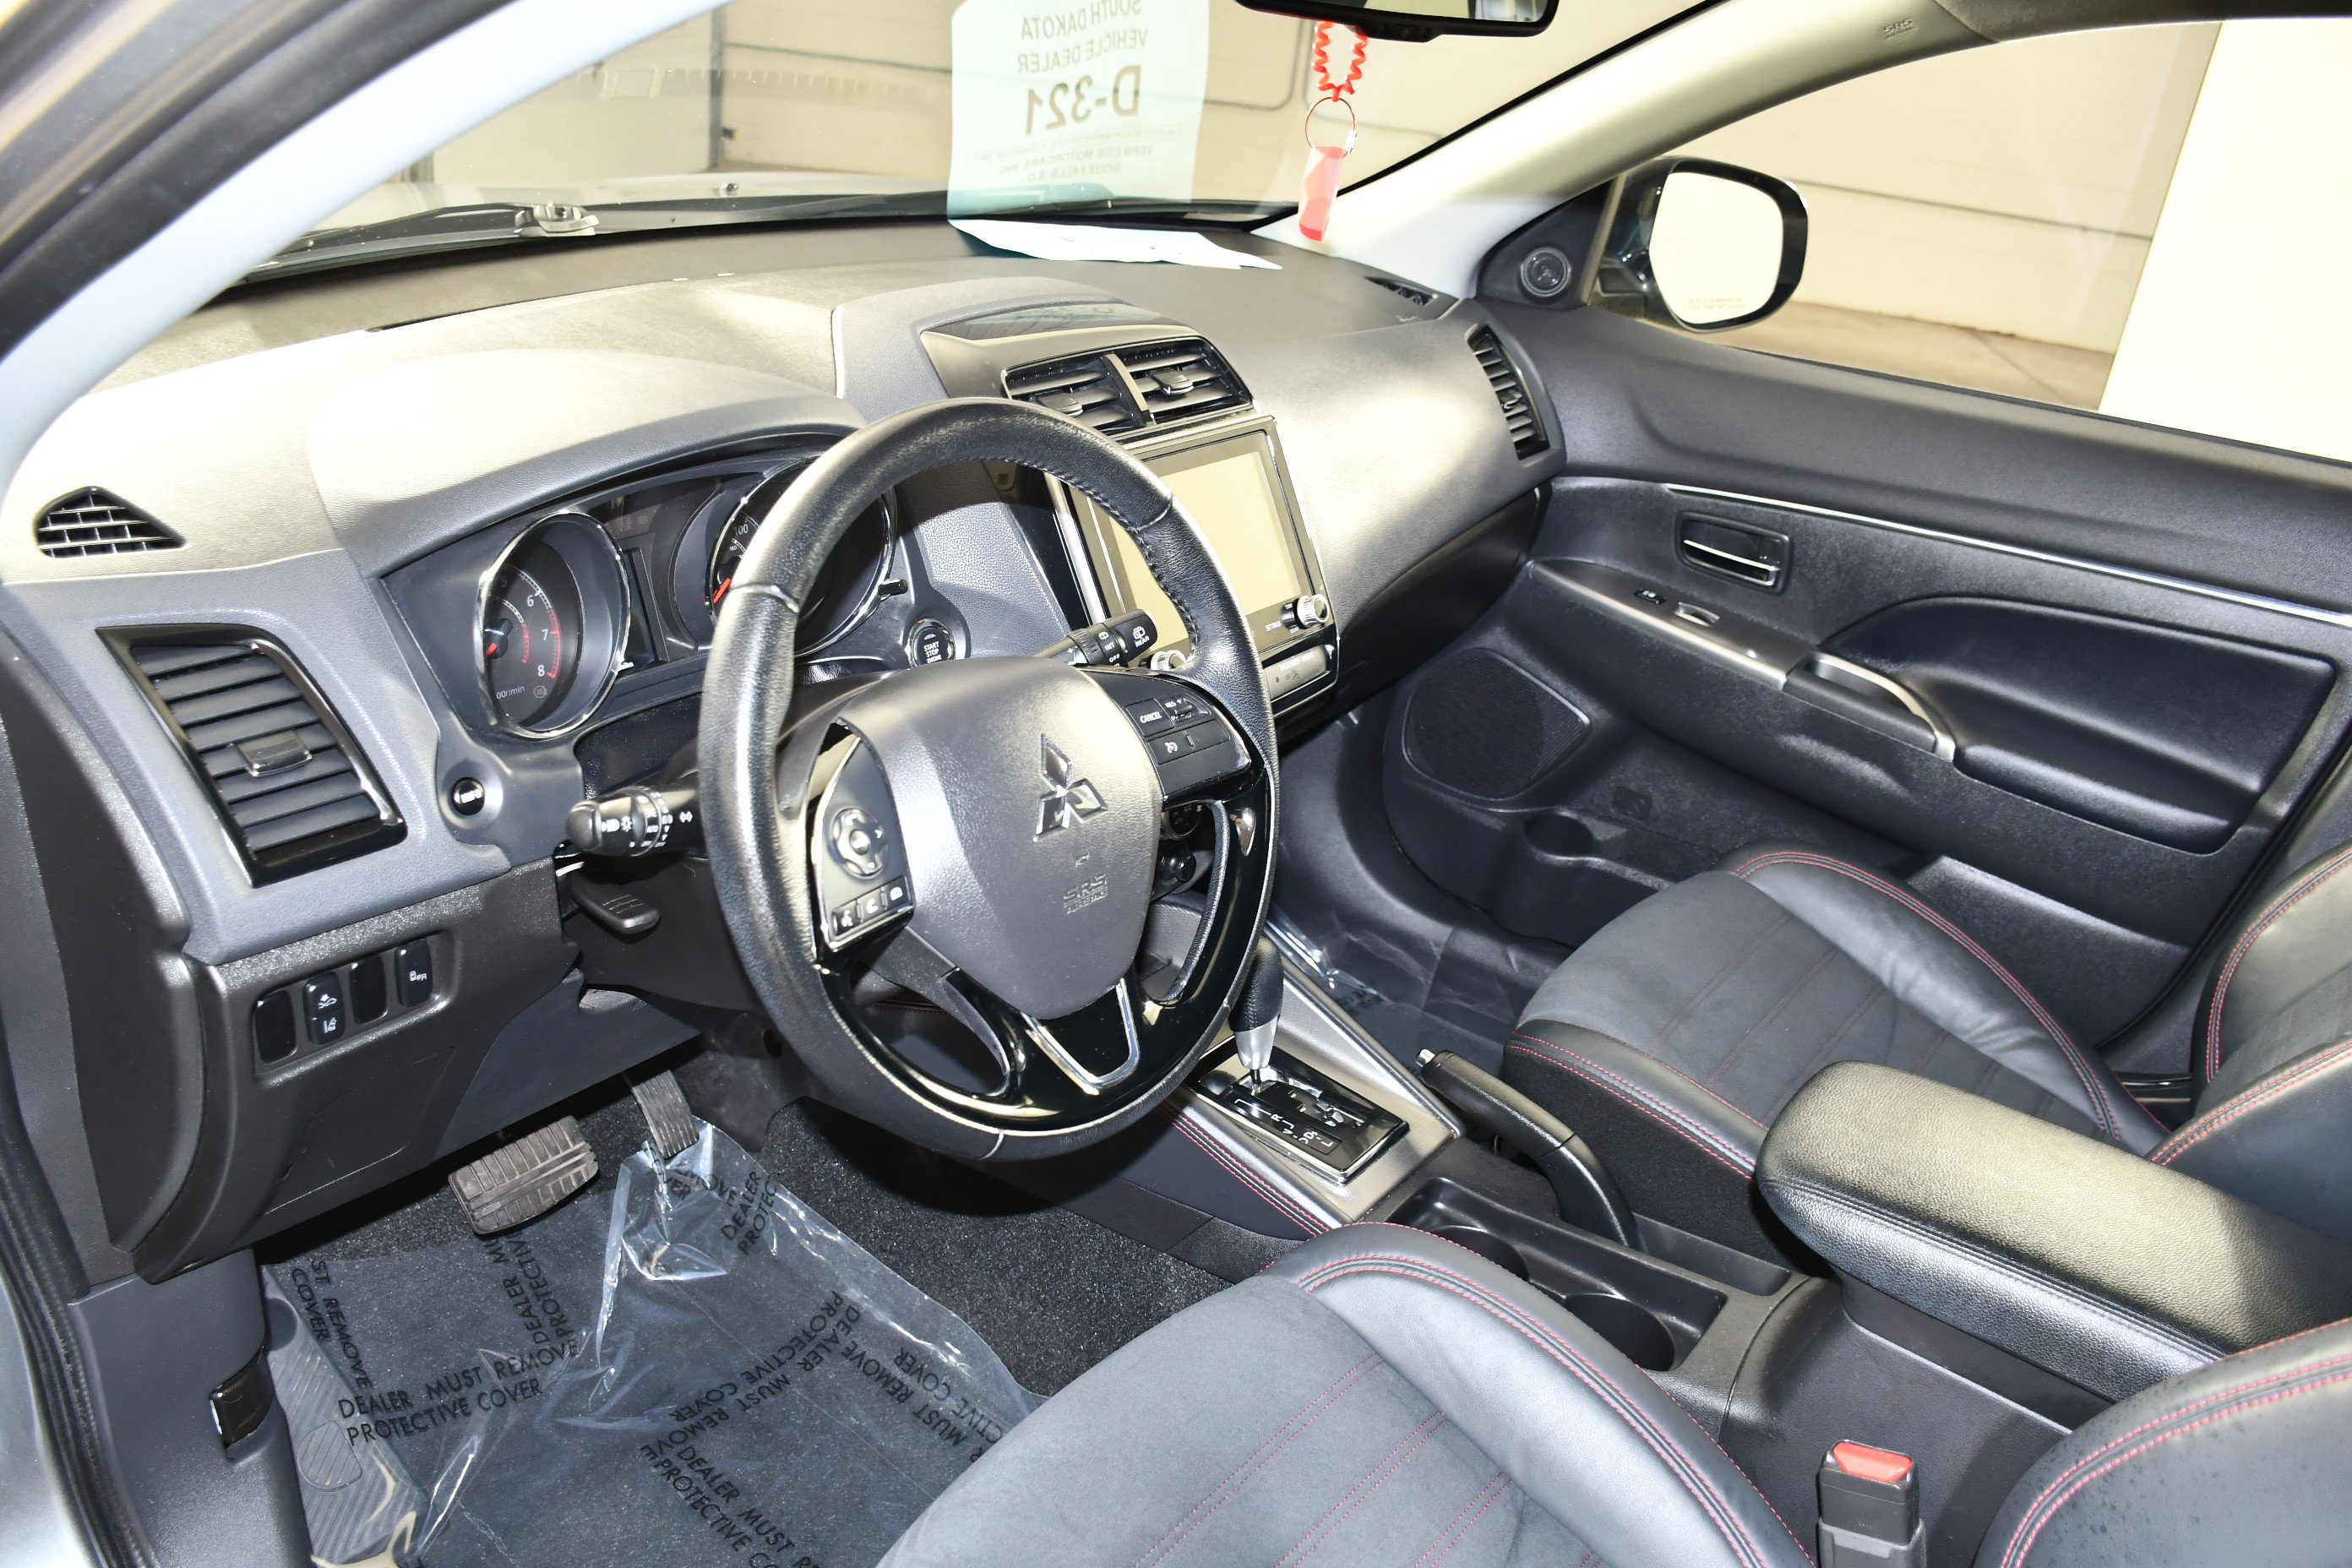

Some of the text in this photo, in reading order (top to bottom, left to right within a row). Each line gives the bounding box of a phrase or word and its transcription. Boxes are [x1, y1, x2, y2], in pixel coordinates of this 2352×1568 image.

[734, 523, 749, 536] 100
[526, 595, 535, 607] 6
[542, 629, 548, 641] 7
[923, 641, 939, 651] START
[925, 649, 939, 657] STOP
[1108, 654, 1120, 663] OFF
[1135, 635, 1150, 647] REAR
[537, 664, 546, 677] 8
[1140, 711, 1162, 723] CANCEL
[1064, 874, 1108, 899] SRS
[721, 1171, 761, 1240] DEALER
[292, 1268, 331, 1342] COVER
[502, 1275, 549, 1344] DEALER
[323, 1298, 374, 1388] REMOVE
[668, 1290, 844, 1422] PROTECTIVE COVER
[338, 1338, 579, 1418] DEALER MUST REMOVE
[640, 1305, 861, 1462] DEALER MUST REMOVE
[841, 1340, 967, 1447] MUST REMOVE
[894, 1348, 951, 1402] COVER
[346, 1378, 543, 1446] PROTECTIVE COVER
[653, 1459, 753, 1552] PROTECTIVE
[677, 1446, 795, 1553] DEALER MUST
